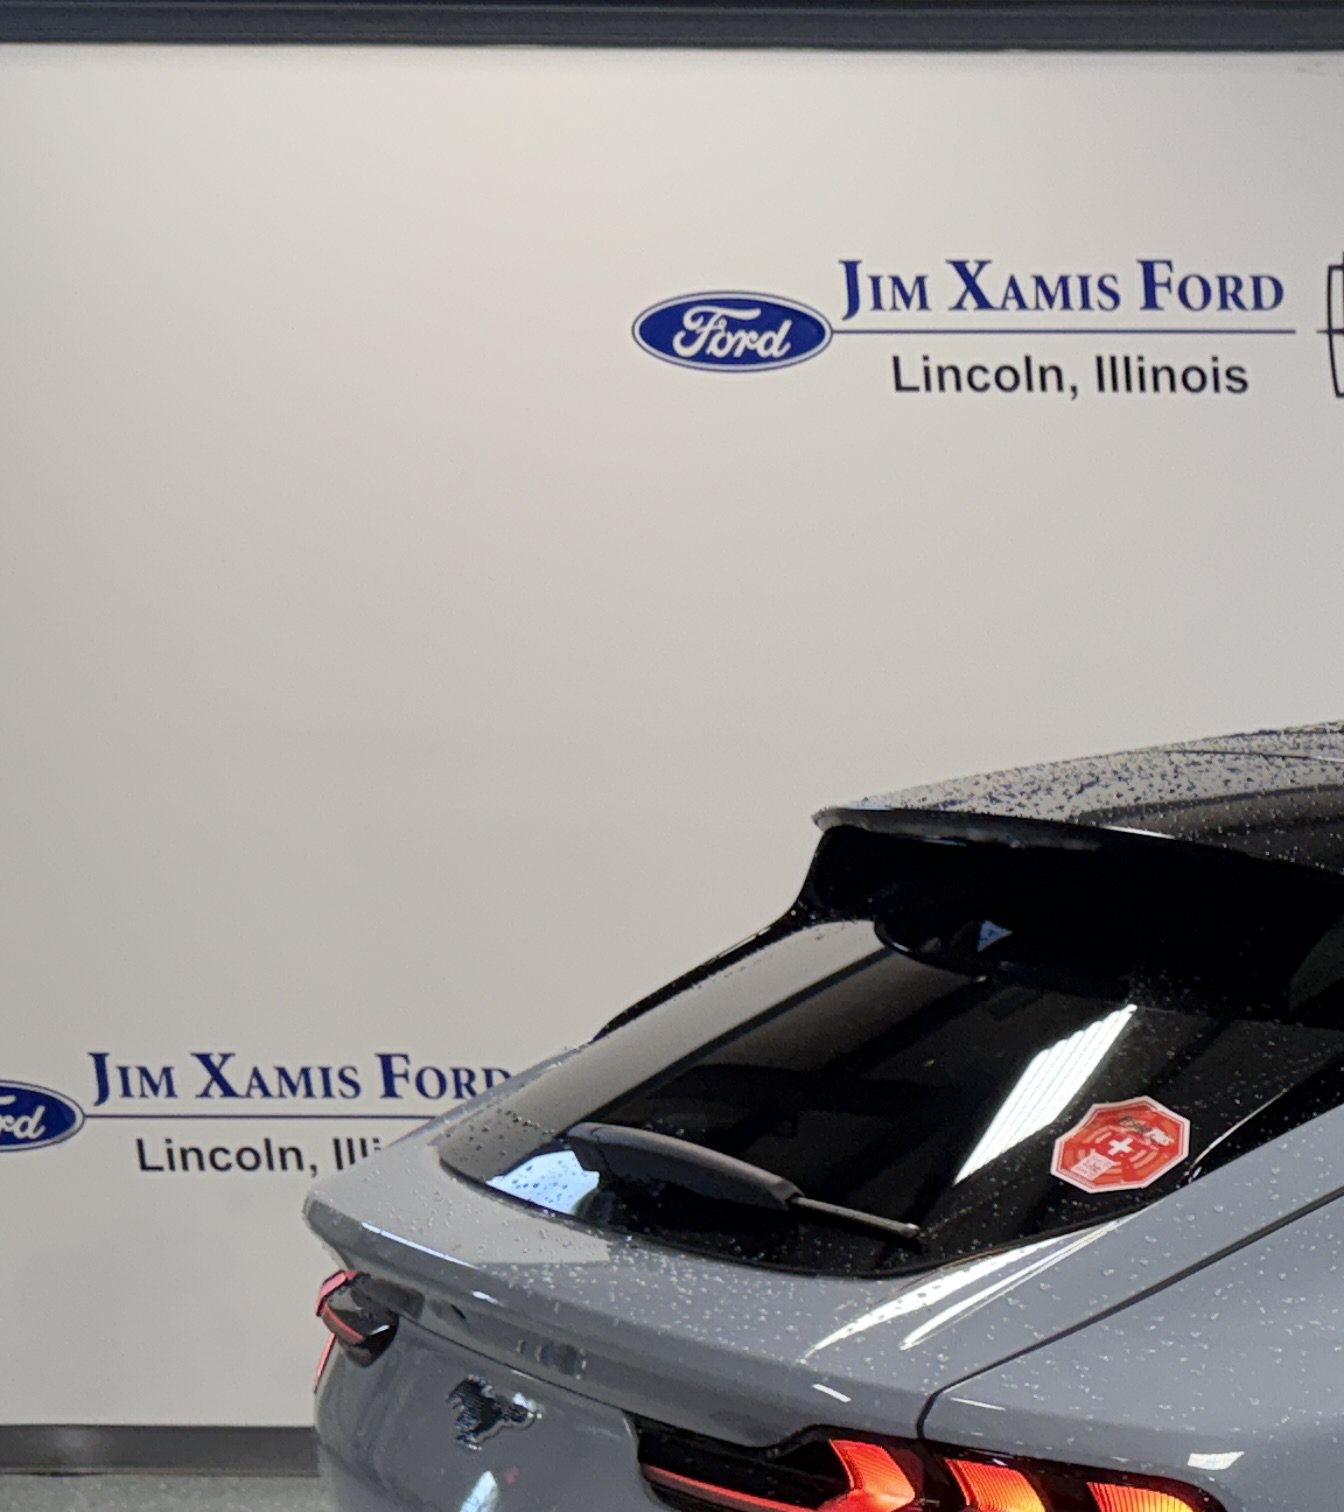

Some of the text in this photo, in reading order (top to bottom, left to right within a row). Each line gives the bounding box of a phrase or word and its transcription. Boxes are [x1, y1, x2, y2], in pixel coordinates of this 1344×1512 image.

[672, 304, 792, 359] Ford
[892, 354, 1249, 399] Lincoln, Illinois
[137, 1137, 318, 1177] Lincoln,
